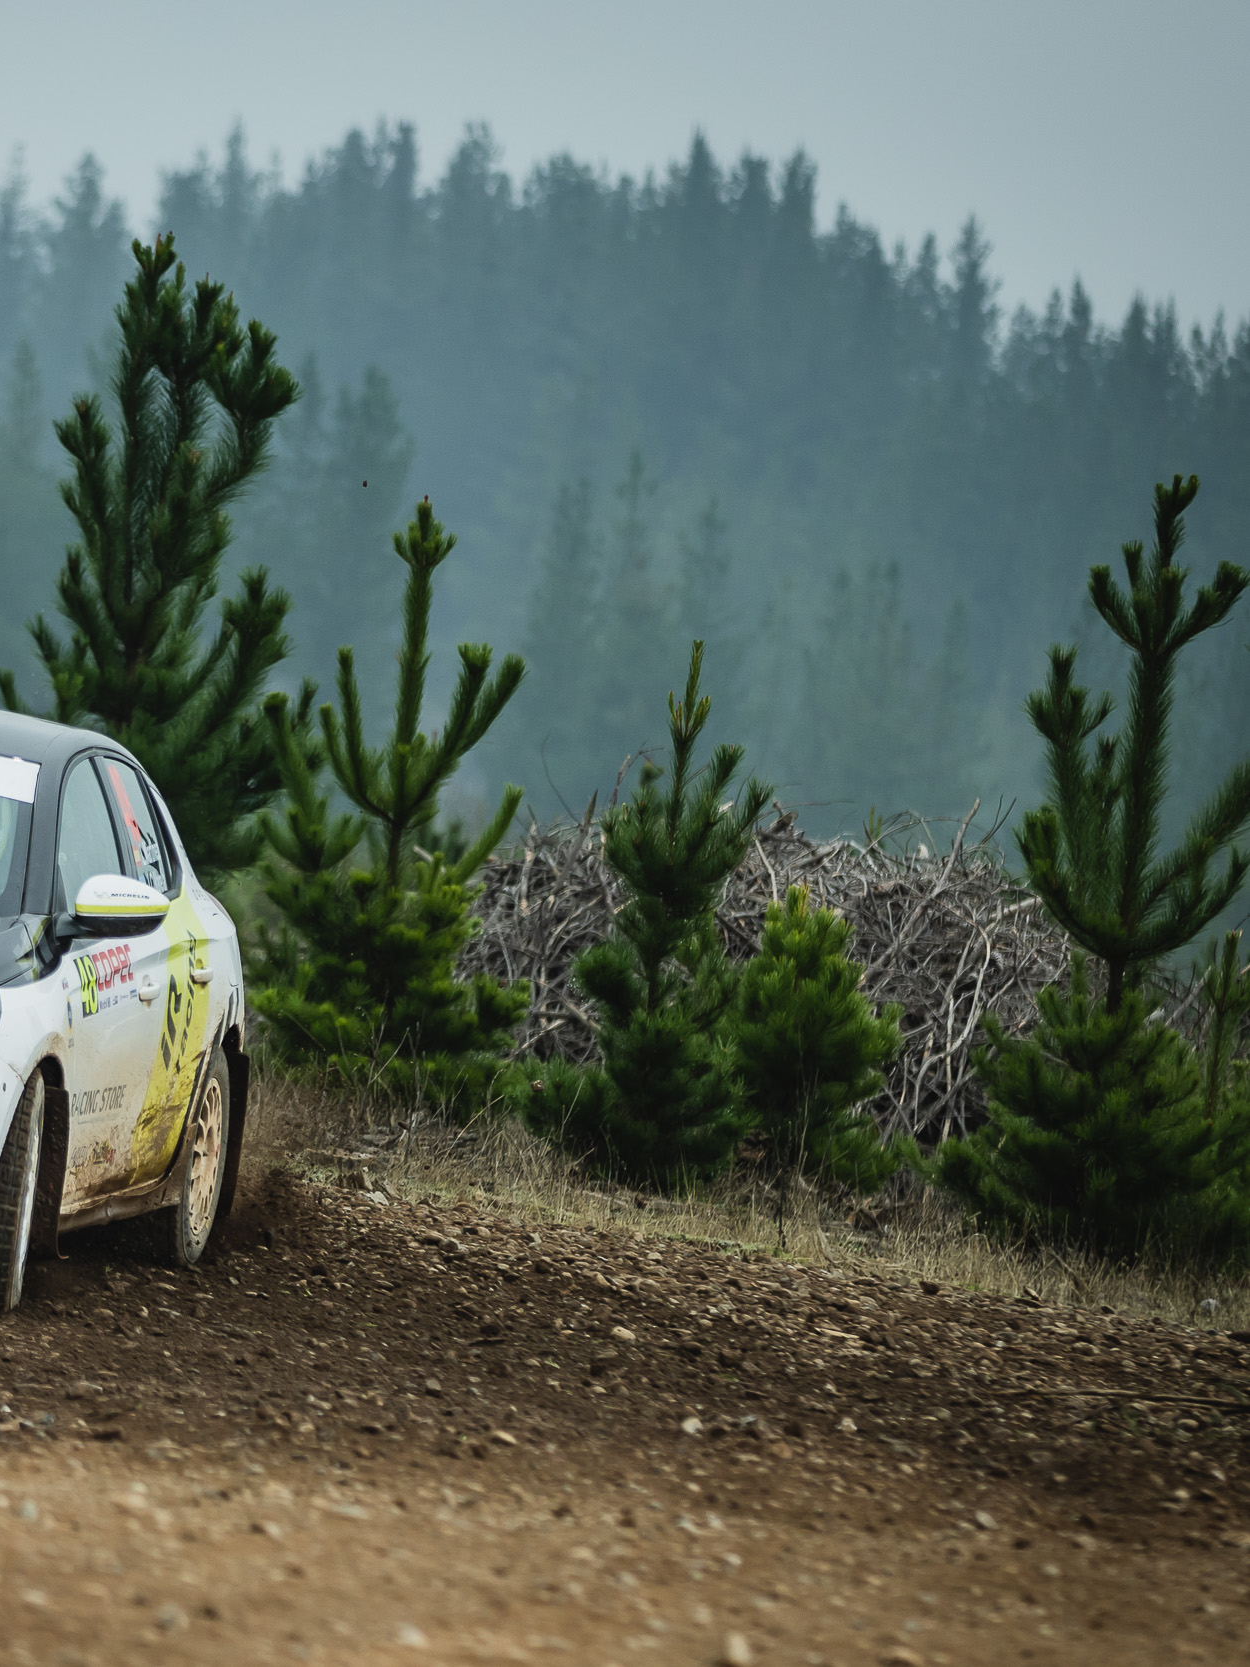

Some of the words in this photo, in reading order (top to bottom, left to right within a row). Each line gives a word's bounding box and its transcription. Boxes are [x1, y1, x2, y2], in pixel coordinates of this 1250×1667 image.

[75, 954, 99, 1015] 48
[91, 943, 134, 993] COPEC
[99, 1084, 127, 1112] STORE
